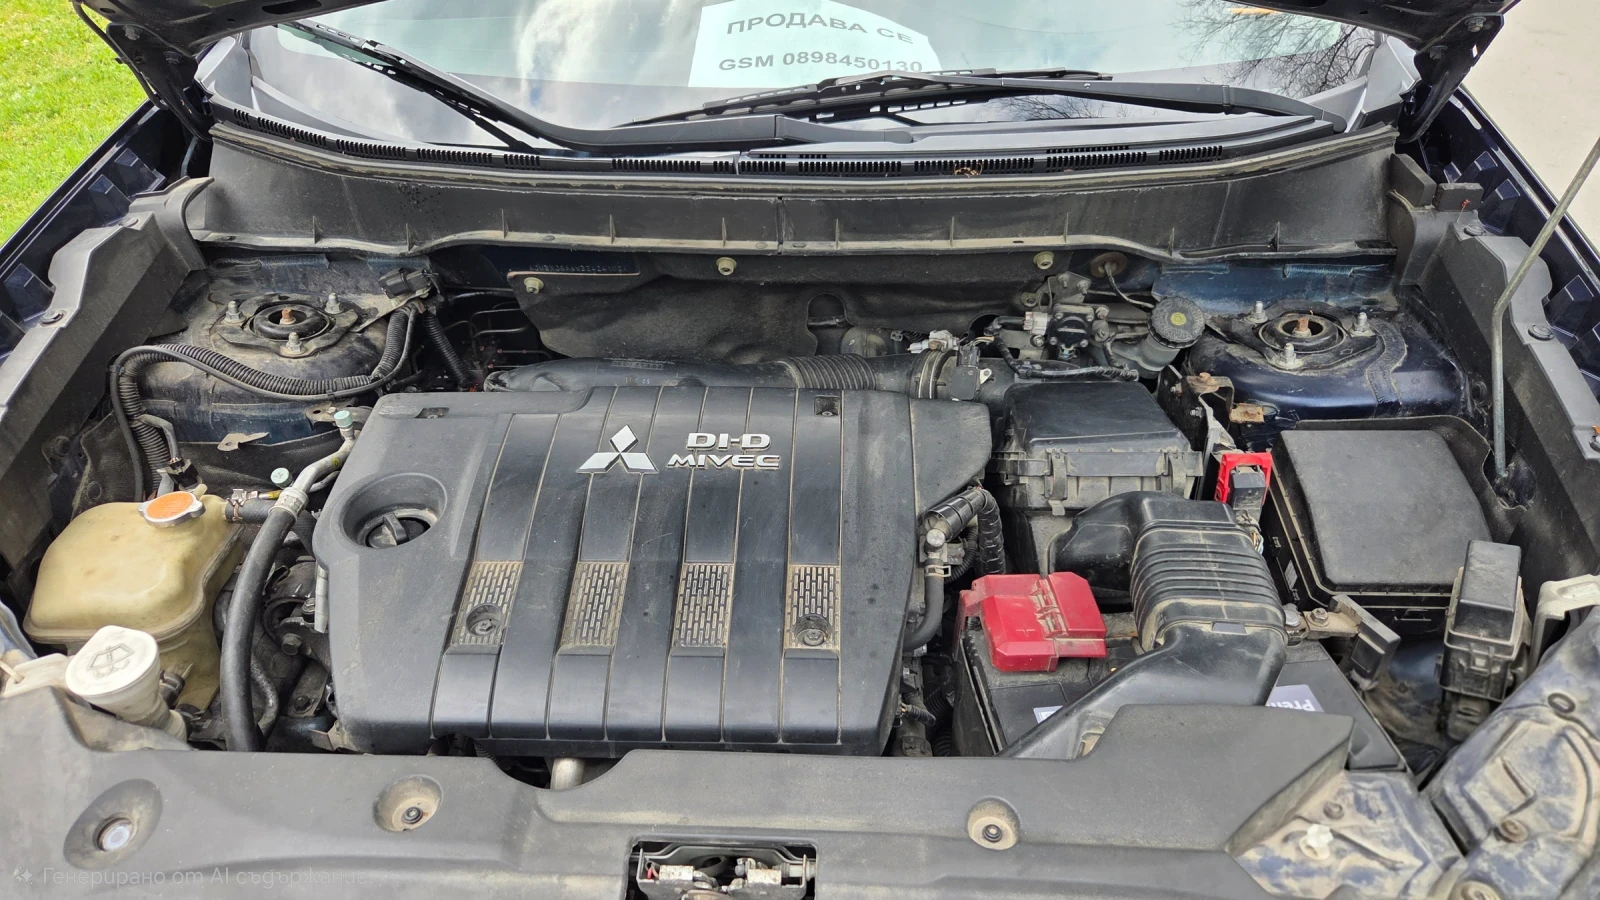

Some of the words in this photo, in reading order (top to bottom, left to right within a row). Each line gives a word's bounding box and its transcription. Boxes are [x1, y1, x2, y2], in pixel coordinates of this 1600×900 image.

[727, 12, 868, 35] ПРОДАВА
[876, 28, 914, 45] СЕ
[719, 54, 774, 71] GSM
[782, 50, 923, 73] 0898450130
[686, 432, 771, 451] DI-D
[667, 453, 780, 469] MIVEC
